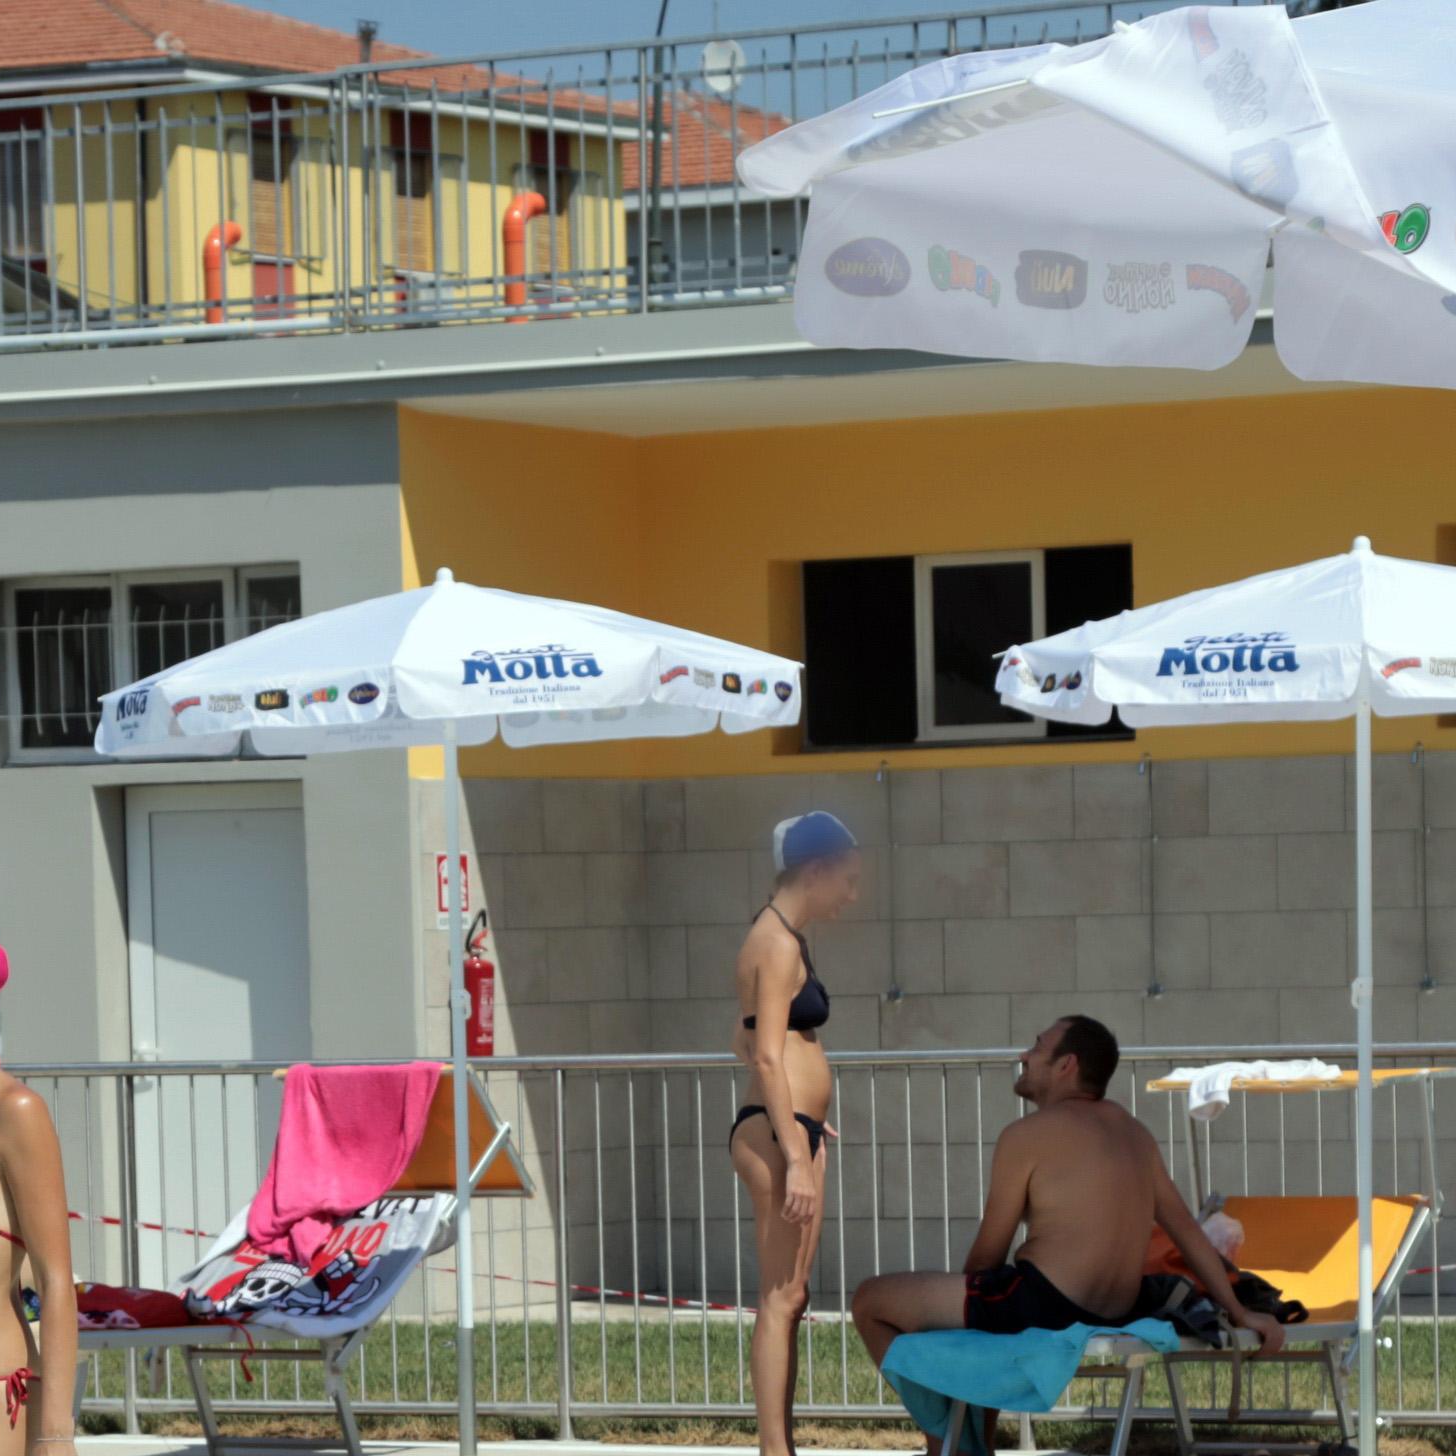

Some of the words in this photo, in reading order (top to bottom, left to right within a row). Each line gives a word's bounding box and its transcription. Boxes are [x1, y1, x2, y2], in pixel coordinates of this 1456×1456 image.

[461, 652, 604, 685] Motta
[1156, 643, 1300, 677] Motta
[489, 686, 538, 696] Tradizione
[542, 684, 581, 693] Italiana
